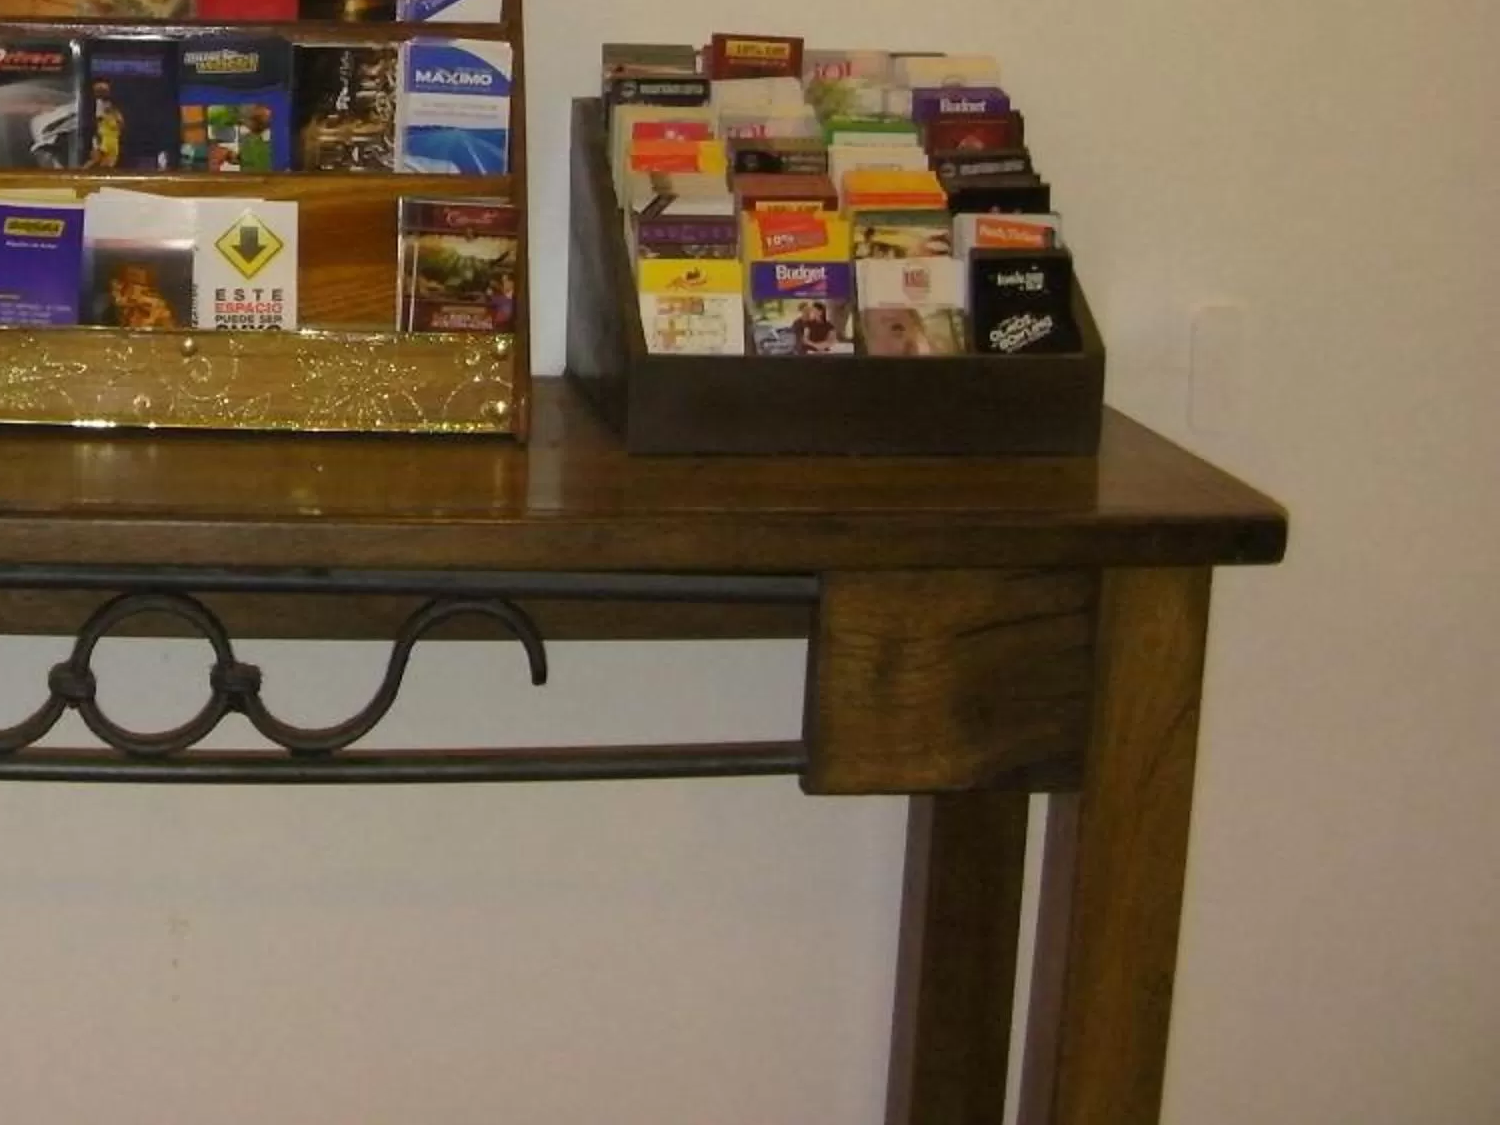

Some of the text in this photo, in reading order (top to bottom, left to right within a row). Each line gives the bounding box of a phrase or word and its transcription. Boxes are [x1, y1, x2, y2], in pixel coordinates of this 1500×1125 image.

[775, 264, 827, 283] Budget
[214, 287, 284, 302] ESTE
[214, 302, 283, 313] ESPACIO
[214, 314, 283, 324] PUEDE SER
